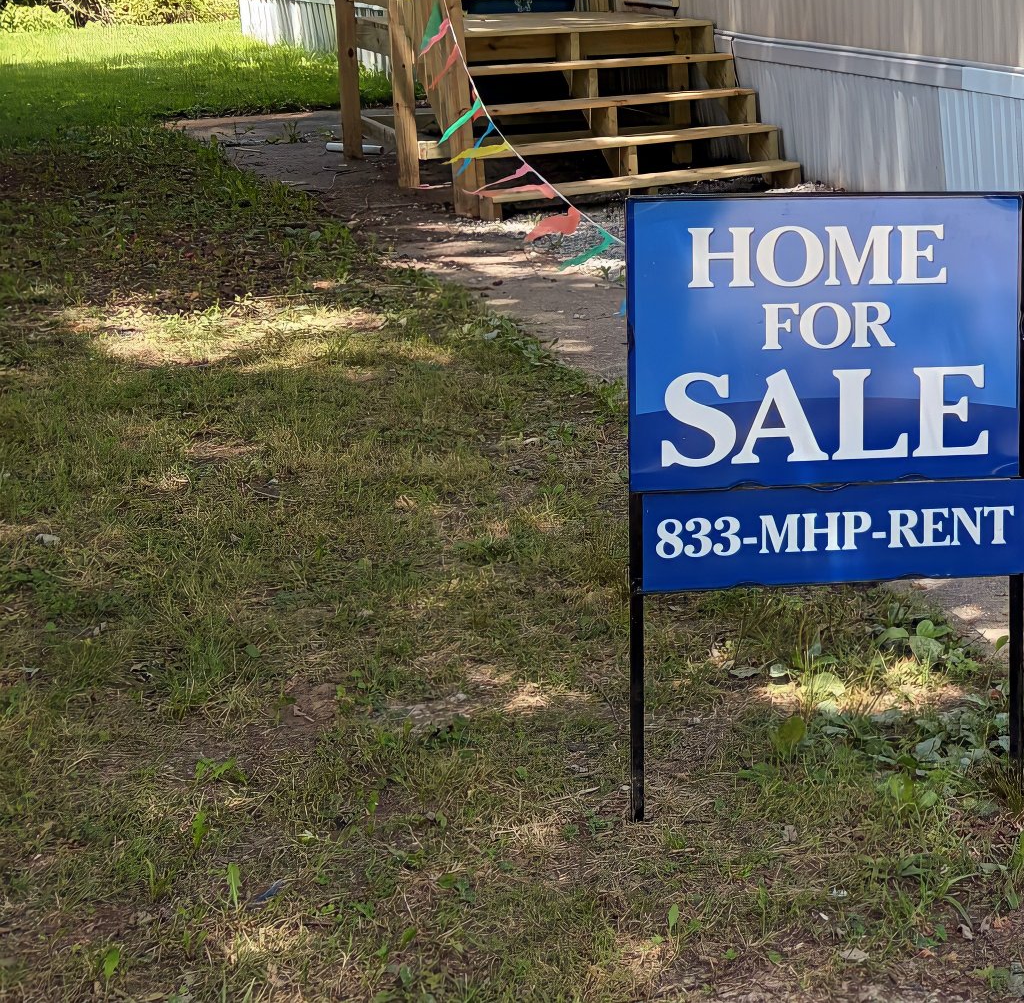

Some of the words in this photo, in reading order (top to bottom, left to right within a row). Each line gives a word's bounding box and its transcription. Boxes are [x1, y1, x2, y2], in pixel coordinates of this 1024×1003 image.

[687, 224, 948, 288] HOME
[761, 301, 896, 350] FOR
[661, 364, 989, 467] SALE
[655, 505, 1015, 559] 833-MHP-RENT
